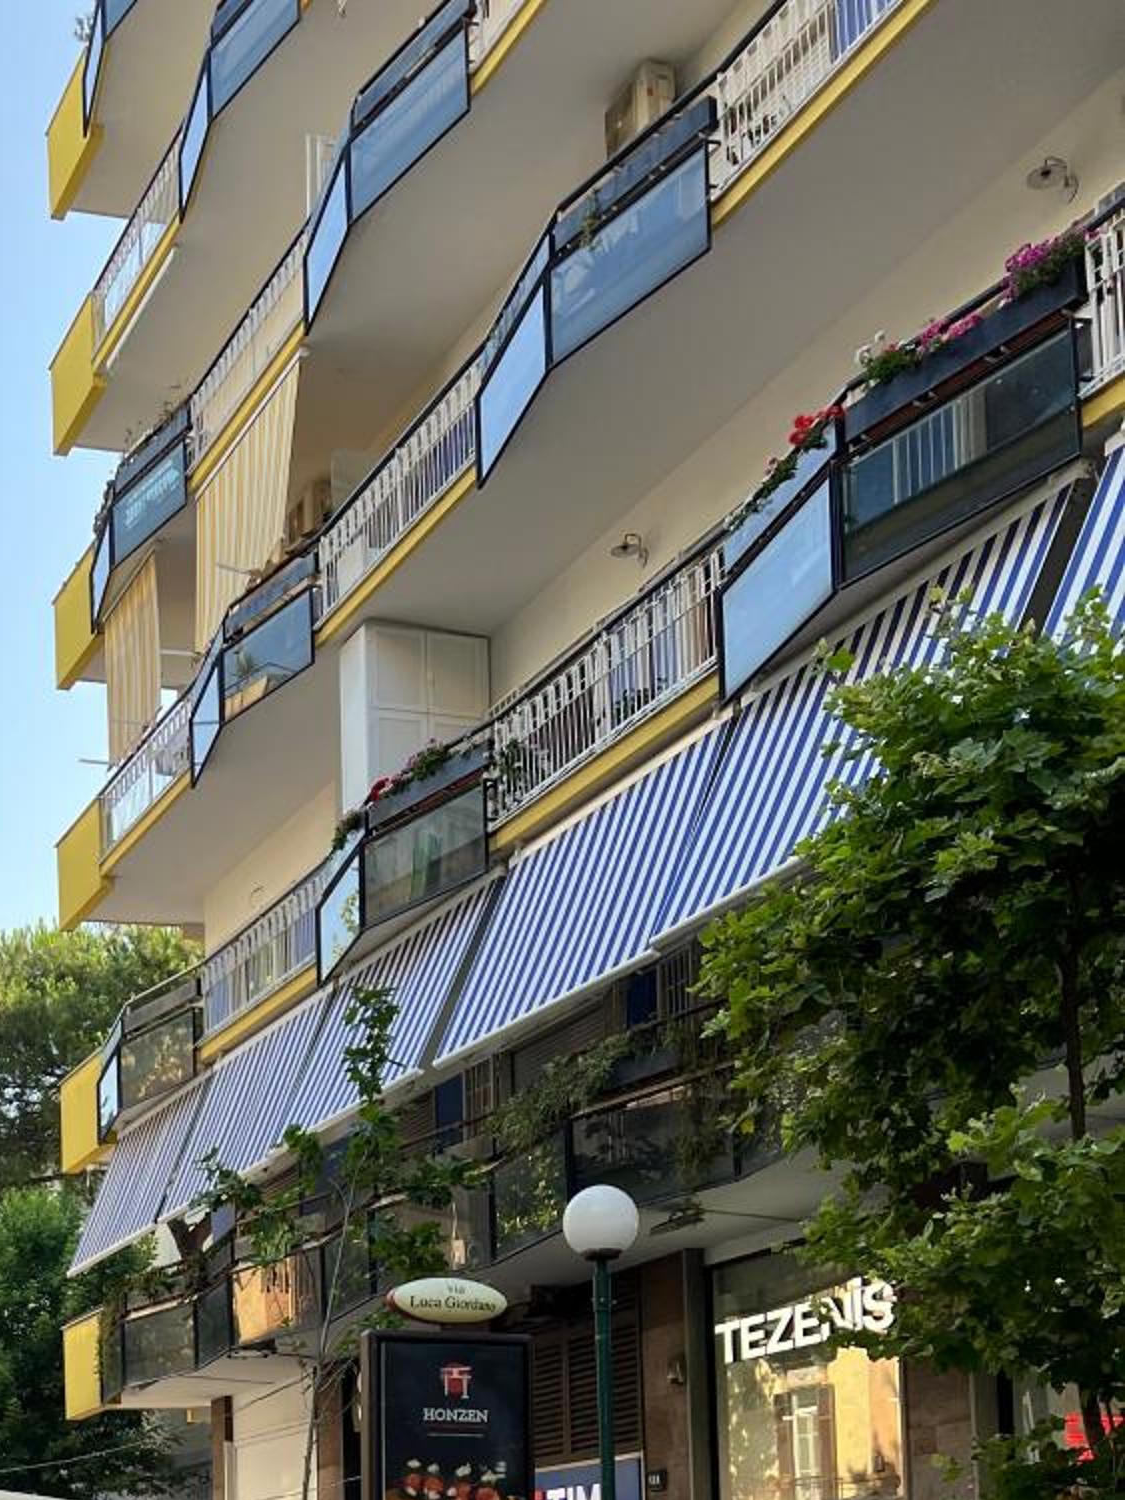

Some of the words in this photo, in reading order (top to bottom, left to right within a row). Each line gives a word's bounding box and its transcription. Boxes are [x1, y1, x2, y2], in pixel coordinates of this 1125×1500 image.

[410, 1295, 442, 1308] Luca
[445, 1295, 496, 1312] Giordano
[714, 1276, 897, 1364] TEZENIS
[423, 1408, 489, 1423] HONZEN
